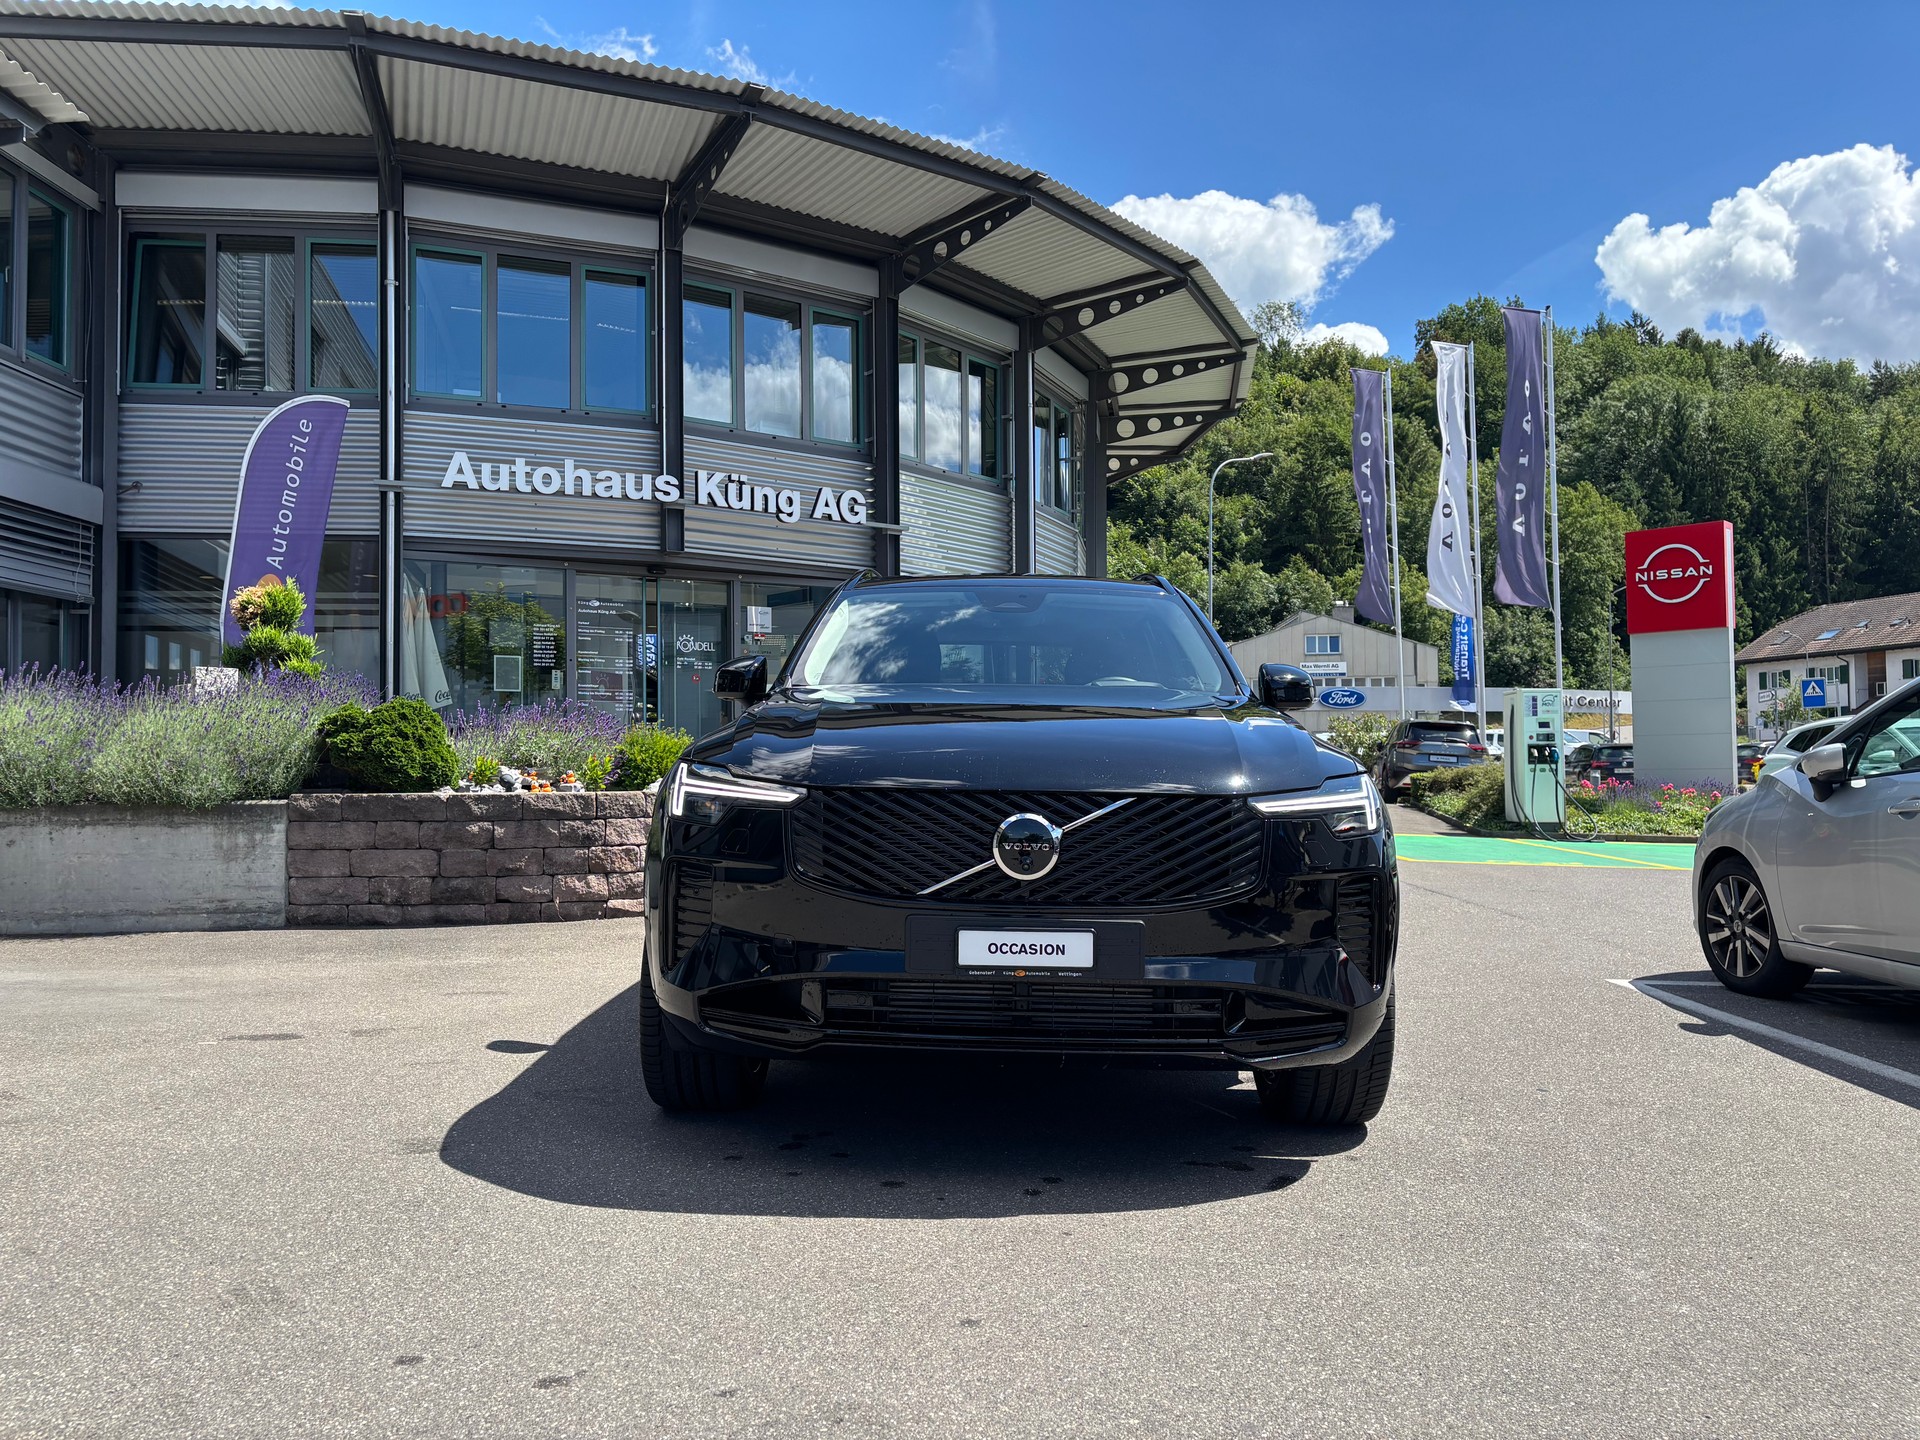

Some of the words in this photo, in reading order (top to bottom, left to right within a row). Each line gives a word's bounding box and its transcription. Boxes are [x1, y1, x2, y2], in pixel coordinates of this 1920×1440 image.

[266, 418, 313, 570] Automobile
[441, 451, 680, 503] Autohaus
[695, 469, 801, 524] Küng
[810, 487, 867, 525] AG
[1635, 564, 1713, 582] NISSAN
[1328, 691, 1357, 704] Ford
[1577, 695, 1622, 707] Center
[1002, 842, 1050, 851] VOLVO
[987, 942, 1066, 956] OCCASION
